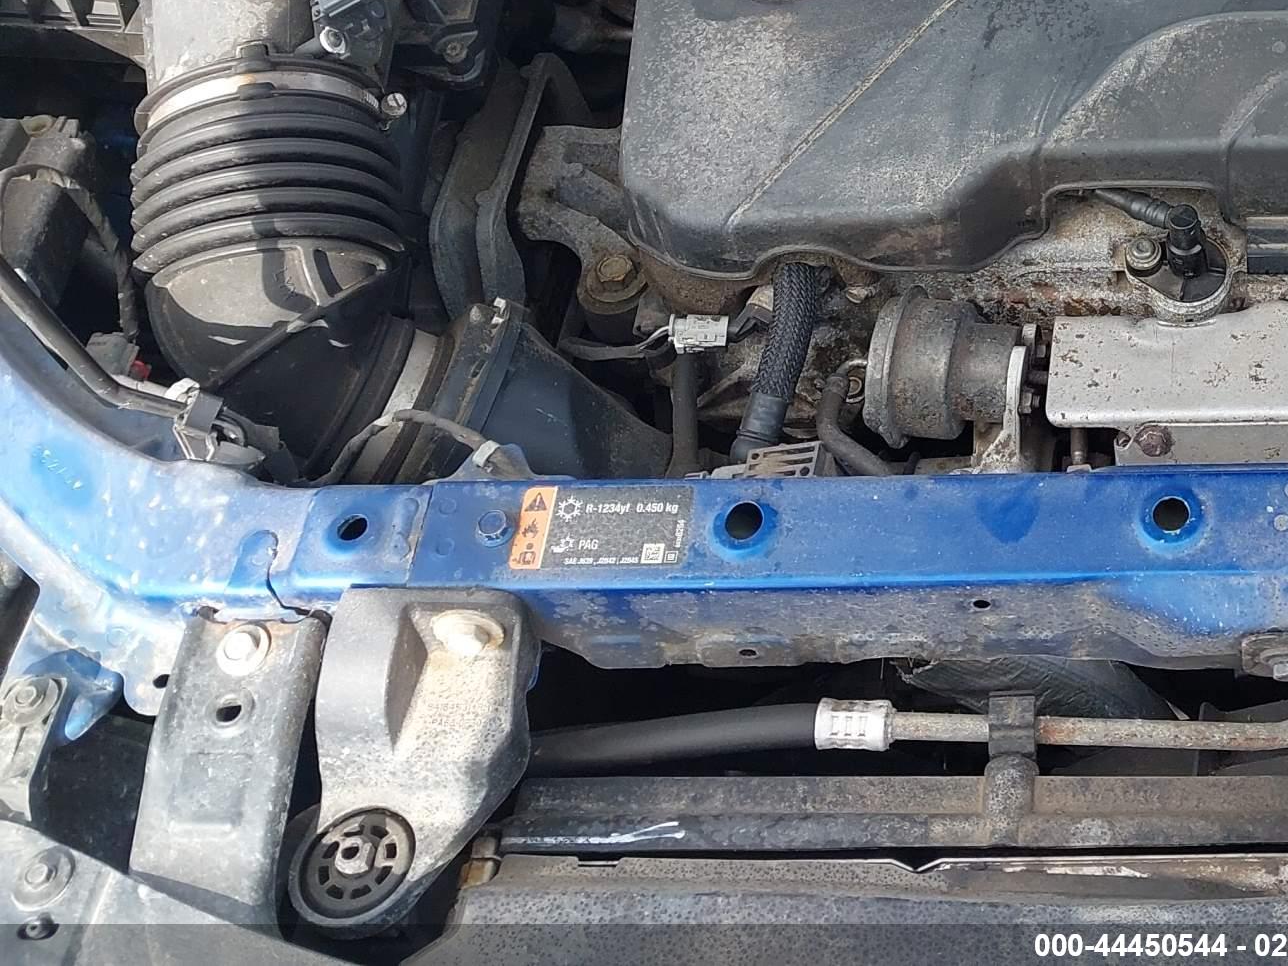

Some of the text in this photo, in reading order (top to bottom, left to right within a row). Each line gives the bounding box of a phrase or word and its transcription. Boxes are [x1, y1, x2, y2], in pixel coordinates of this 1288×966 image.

[585, 502, 679, 515] R-1234yf 0.450 kg
[578, 539, 599, 550] PAG
